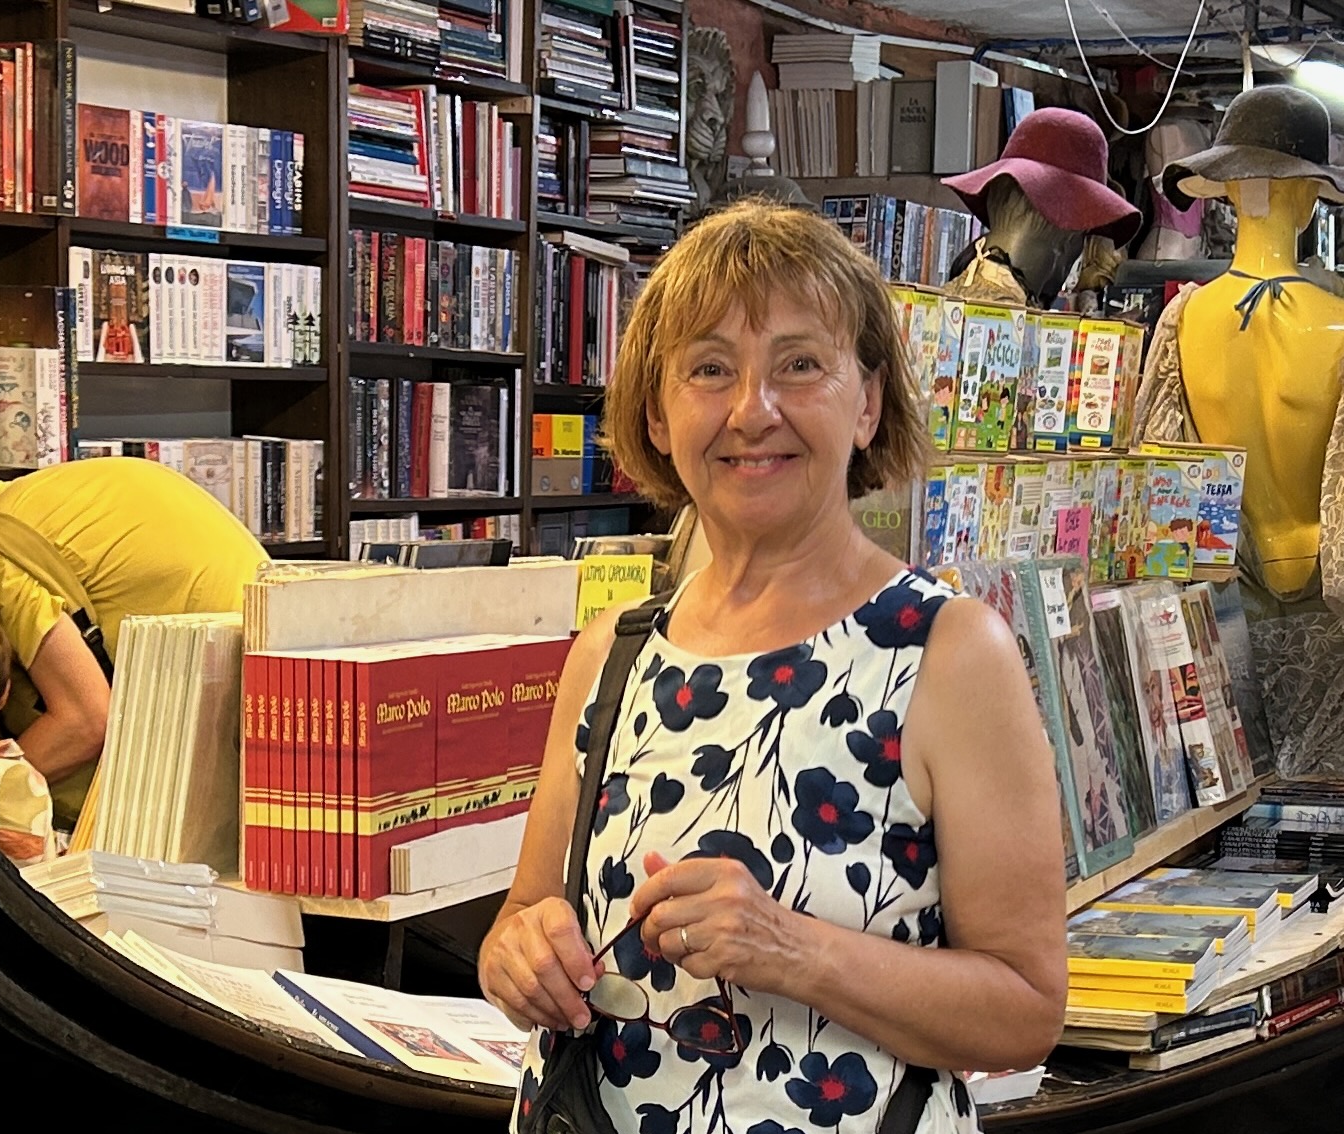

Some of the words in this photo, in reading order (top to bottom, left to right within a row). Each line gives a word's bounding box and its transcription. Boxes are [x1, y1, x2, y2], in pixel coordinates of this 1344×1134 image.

[862, 510, 901, 529] GEO
[446, 693, 480, 715] Marco
[482, 688, 505, 713] Polo
[511, 682, 544, 703] Marco
[245, 694, 253, 714] Polo
[257, 695, 265, 714] Polo
[270, 696, 278, 716] Polo
[376, 702, 406, 725] Marco
[407, 695, 431, 722] Polo
[245, 715, 253, 739] Marco
[257, 715, 265, 739] Marco
